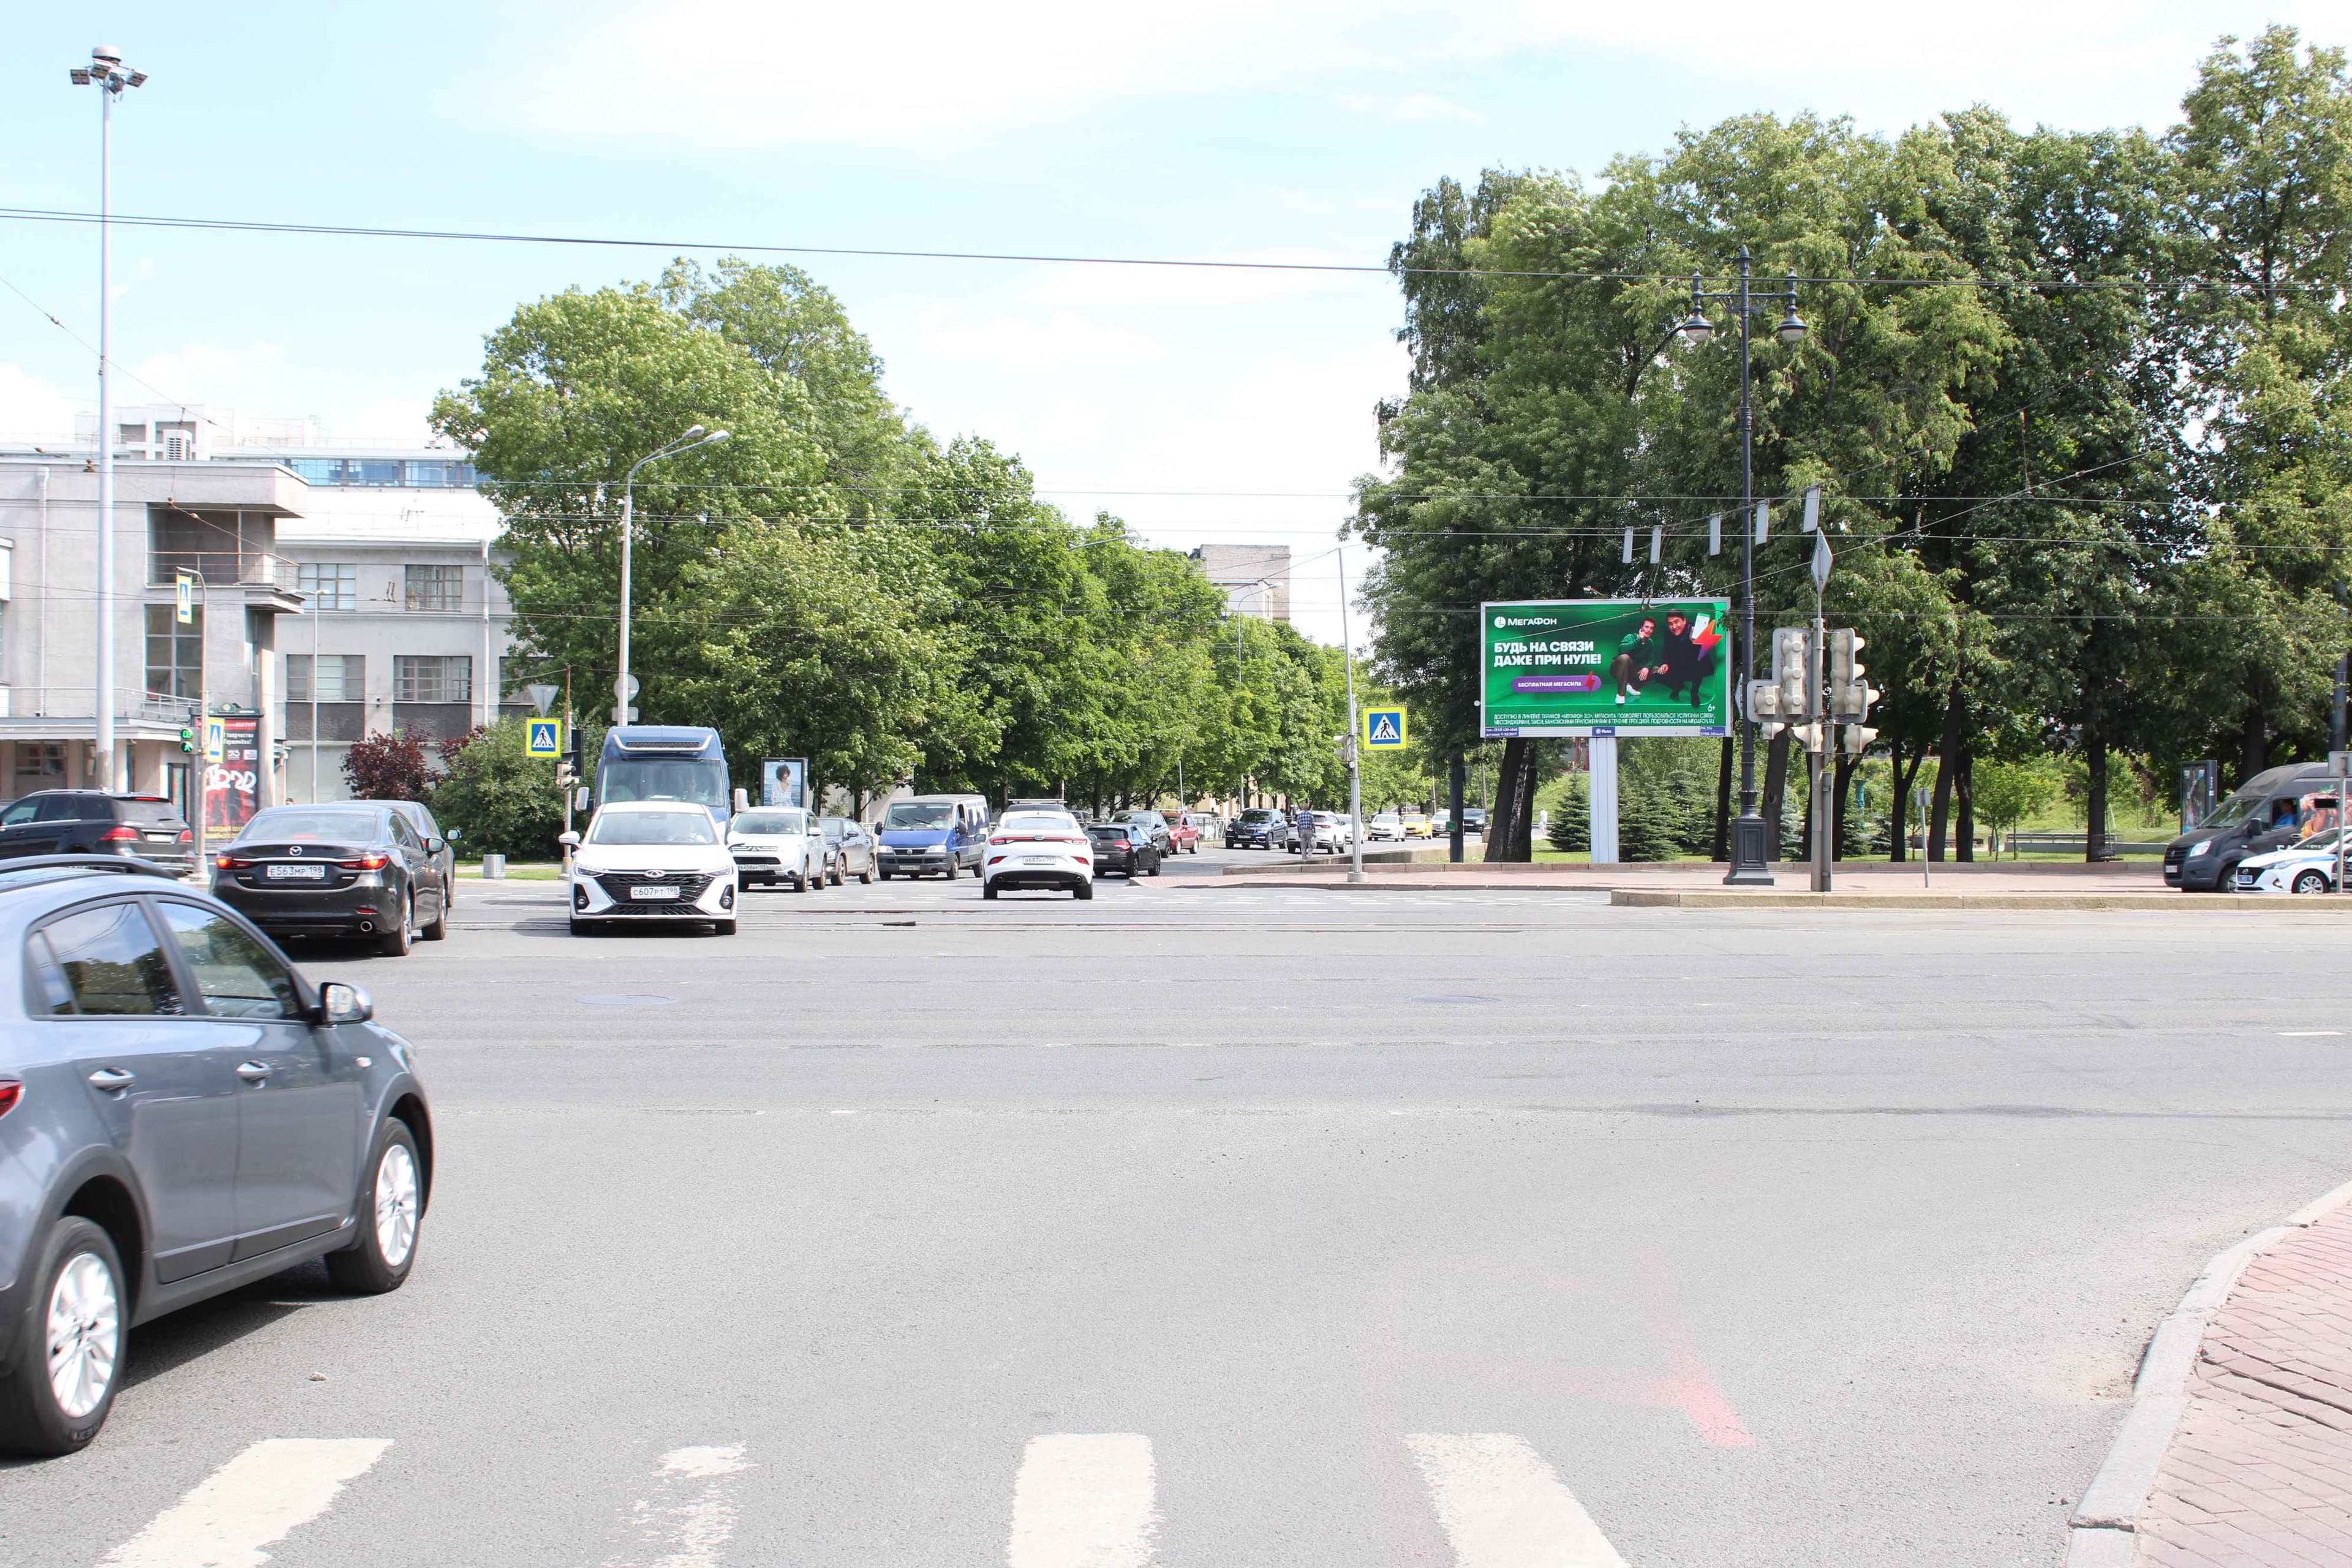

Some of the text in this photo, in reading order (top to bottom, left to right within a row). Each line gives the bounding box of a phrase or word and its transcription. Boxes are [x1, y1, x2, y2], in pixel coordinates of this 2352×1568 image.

[1494, 641, 1594, 654] БУДЬ НА СВЯЗИ
[1494, 654, 1602, 668] ДАЖЕ ПРИ НУЛЕ!
